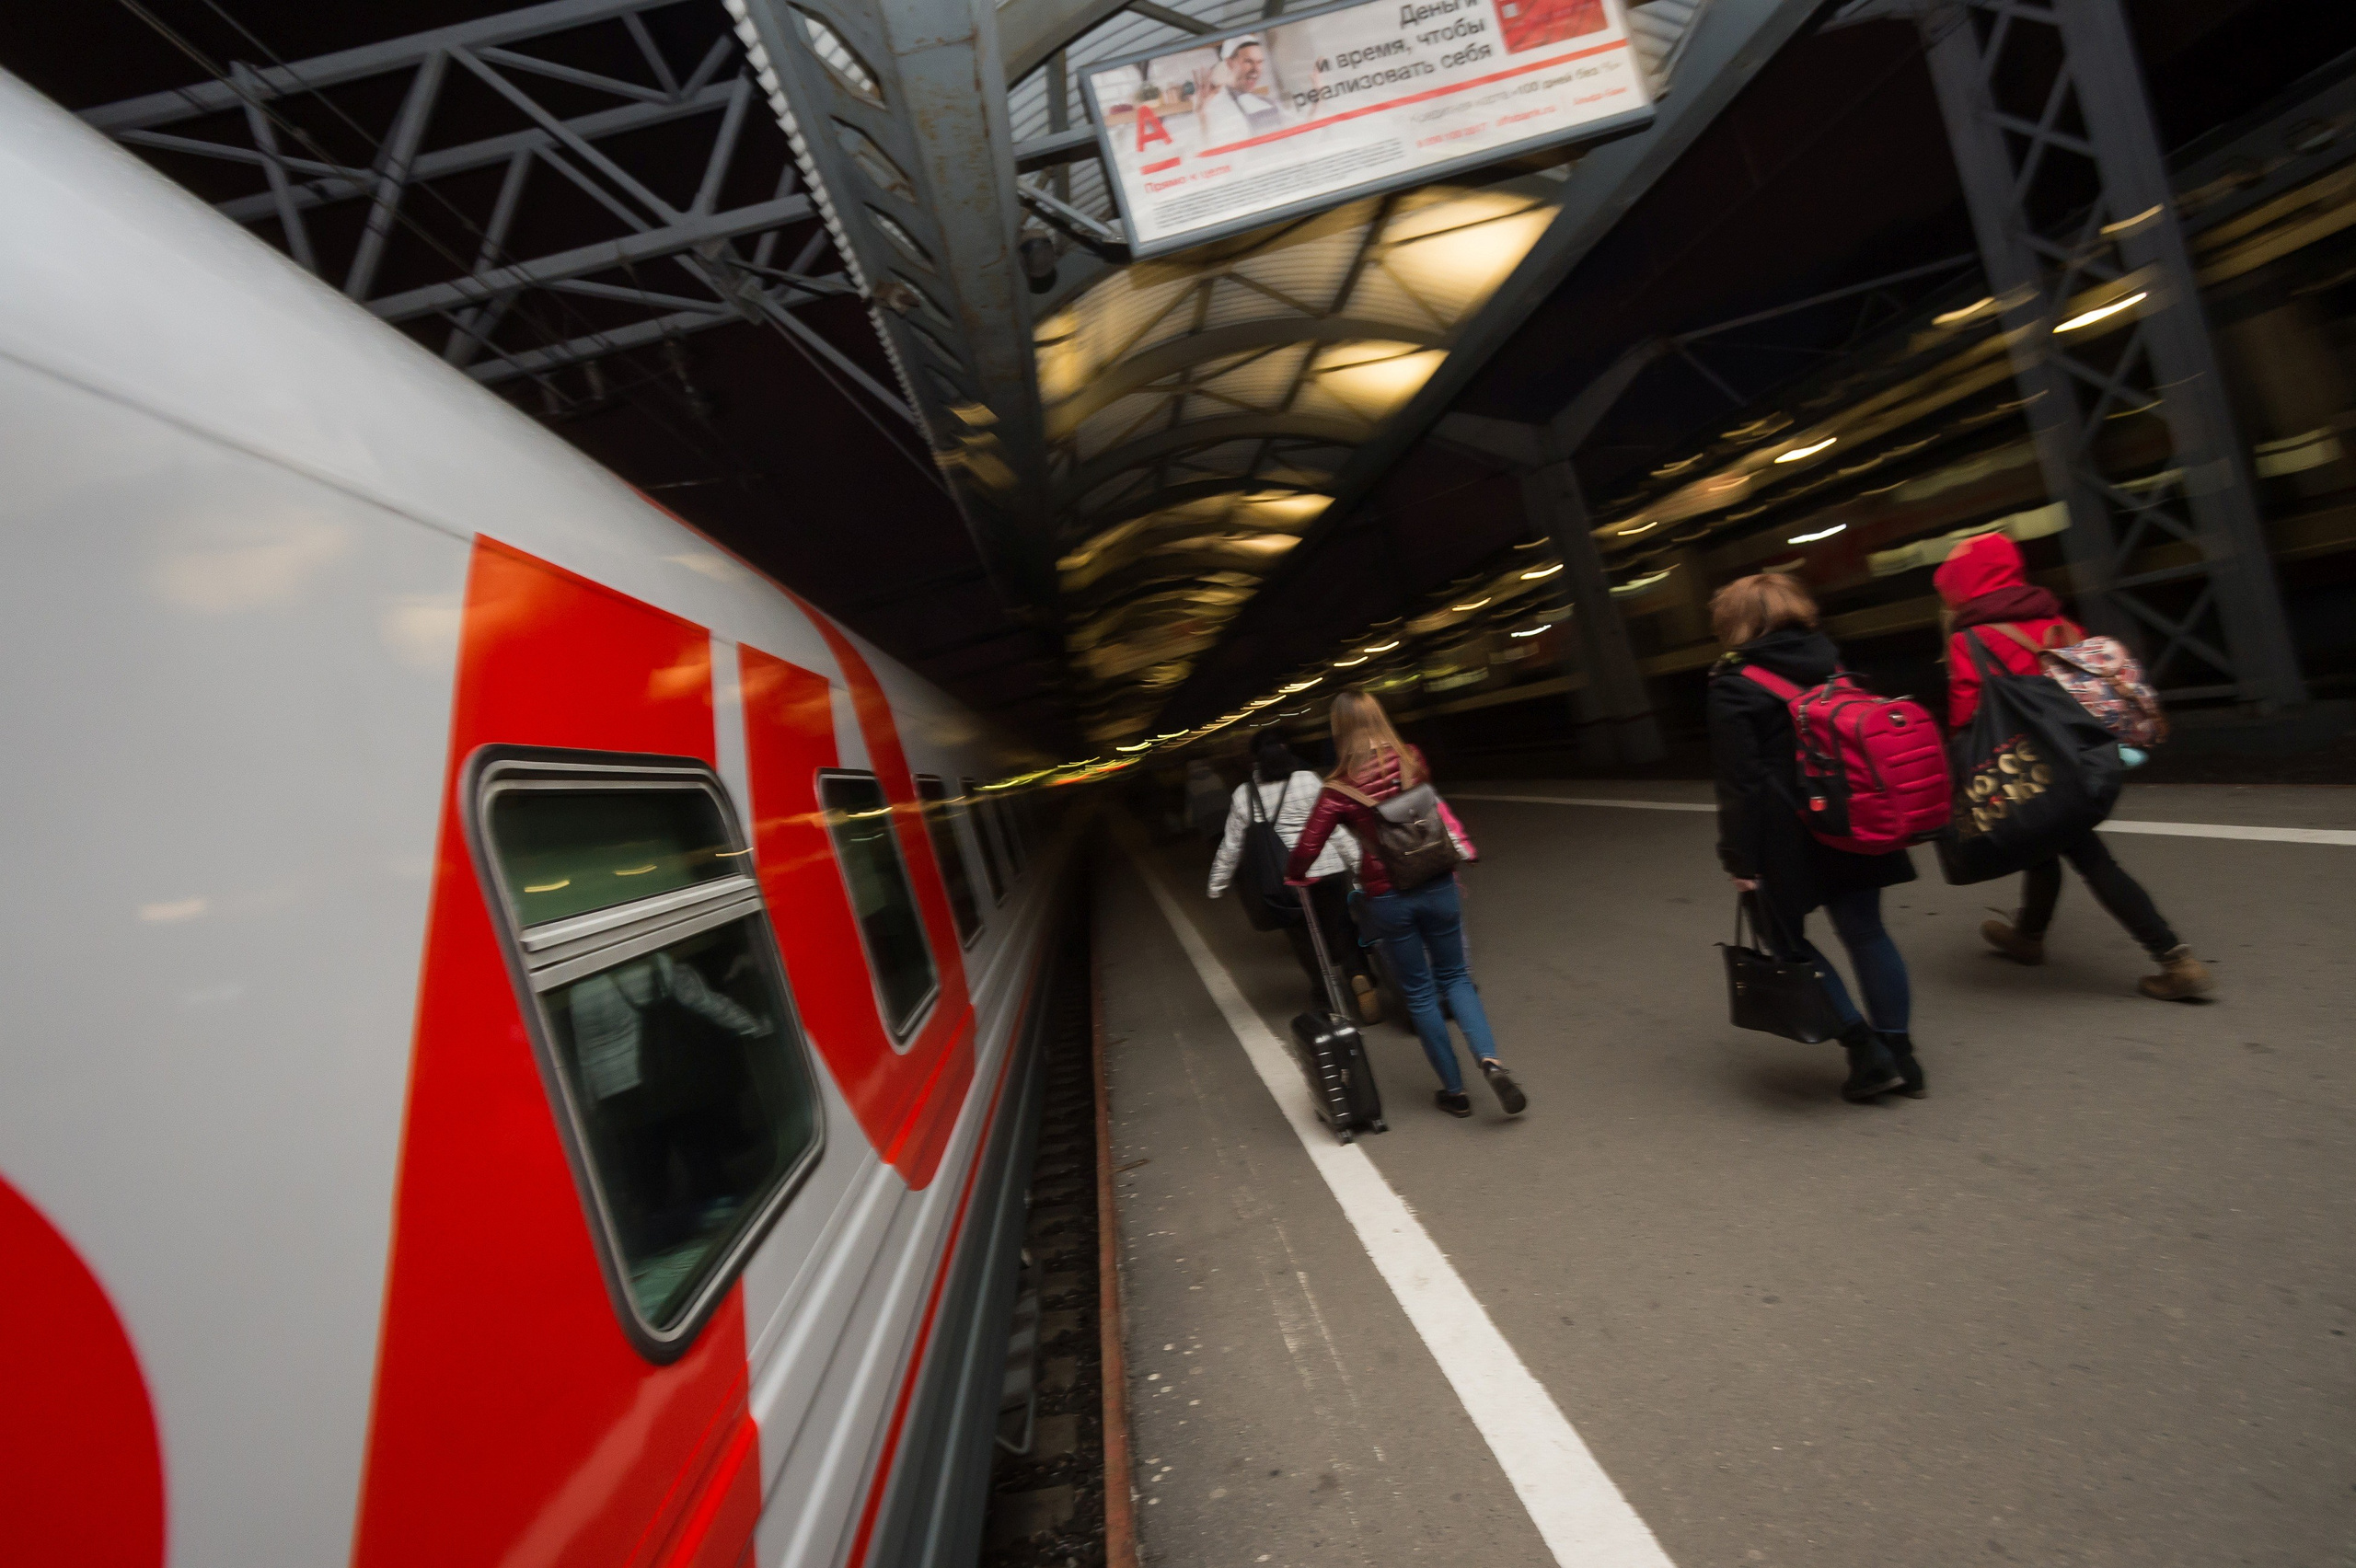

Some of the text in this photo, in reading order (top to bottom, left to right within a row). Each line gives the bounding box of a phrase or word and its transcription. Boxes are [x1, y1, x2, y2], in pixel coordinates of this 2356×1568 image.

[1315, 17, 1486, 73] и время, чтобы
[1292, 42, 1493, 112] реализовать себя
